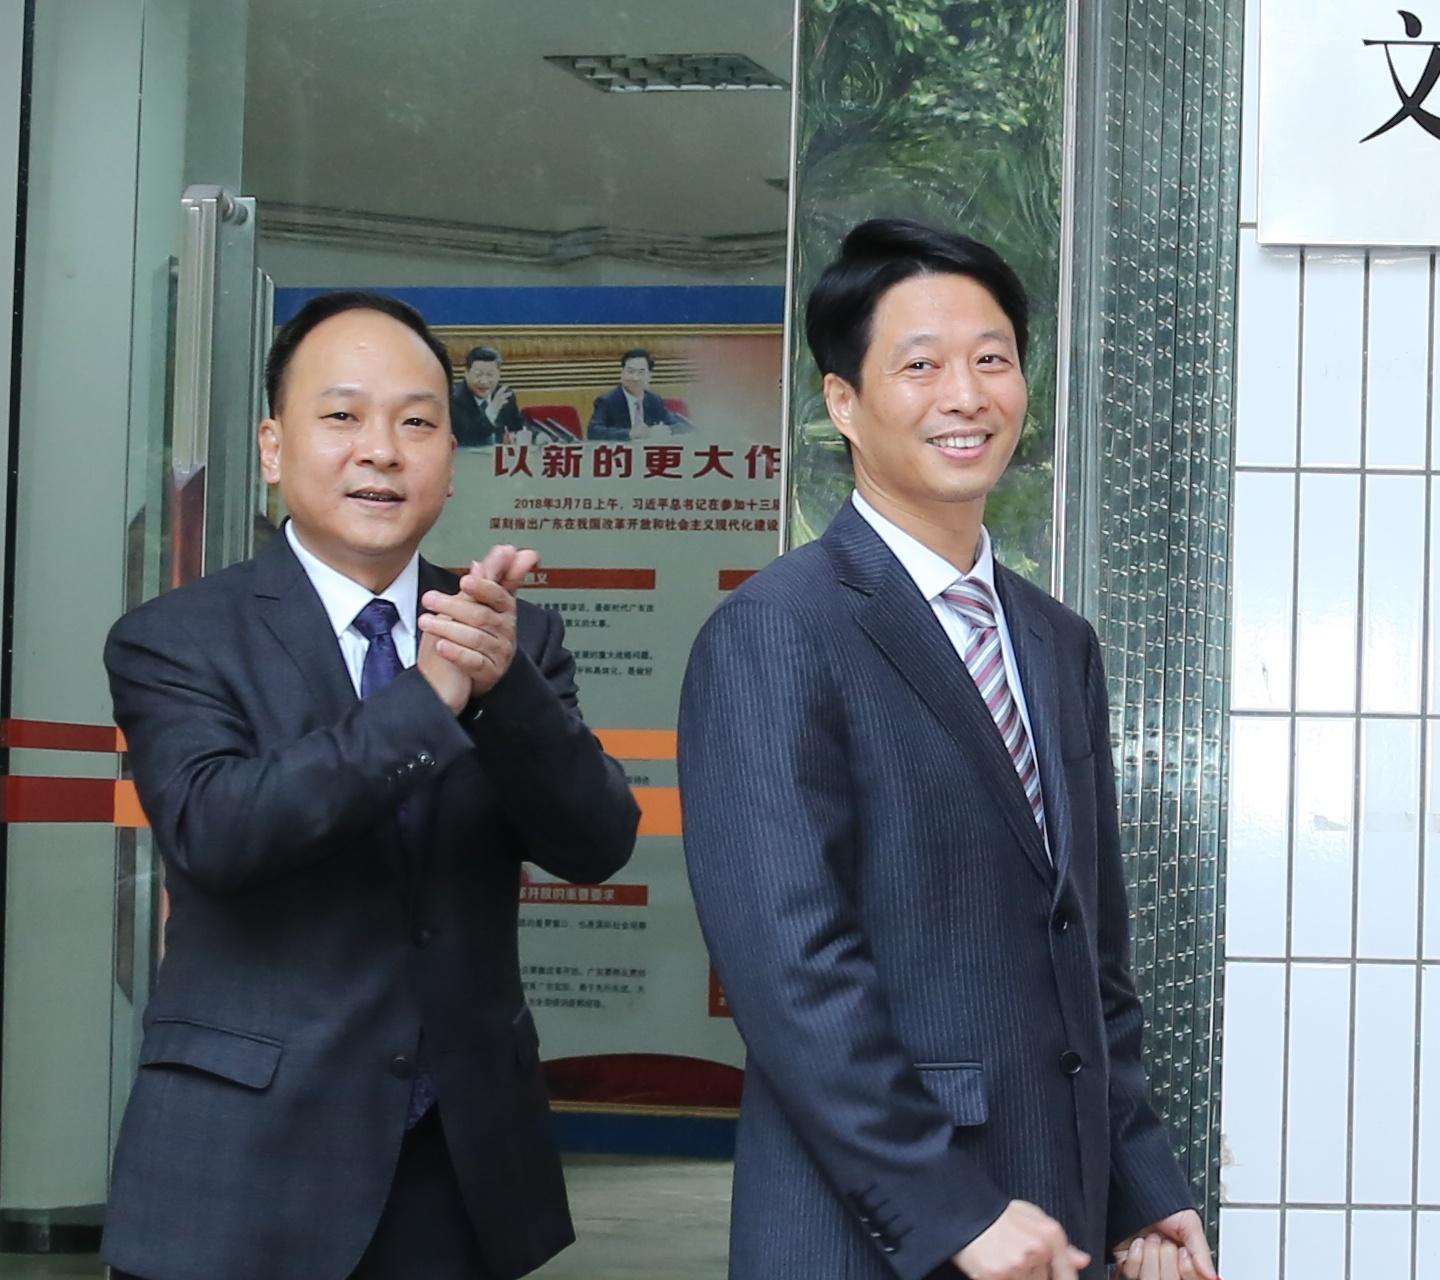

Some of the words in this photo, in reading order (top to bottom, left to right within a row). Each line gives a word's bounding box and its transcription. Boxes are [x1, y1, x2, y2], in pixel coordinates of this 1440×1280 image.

[494, 445, 781, 479] 以新的更大作
